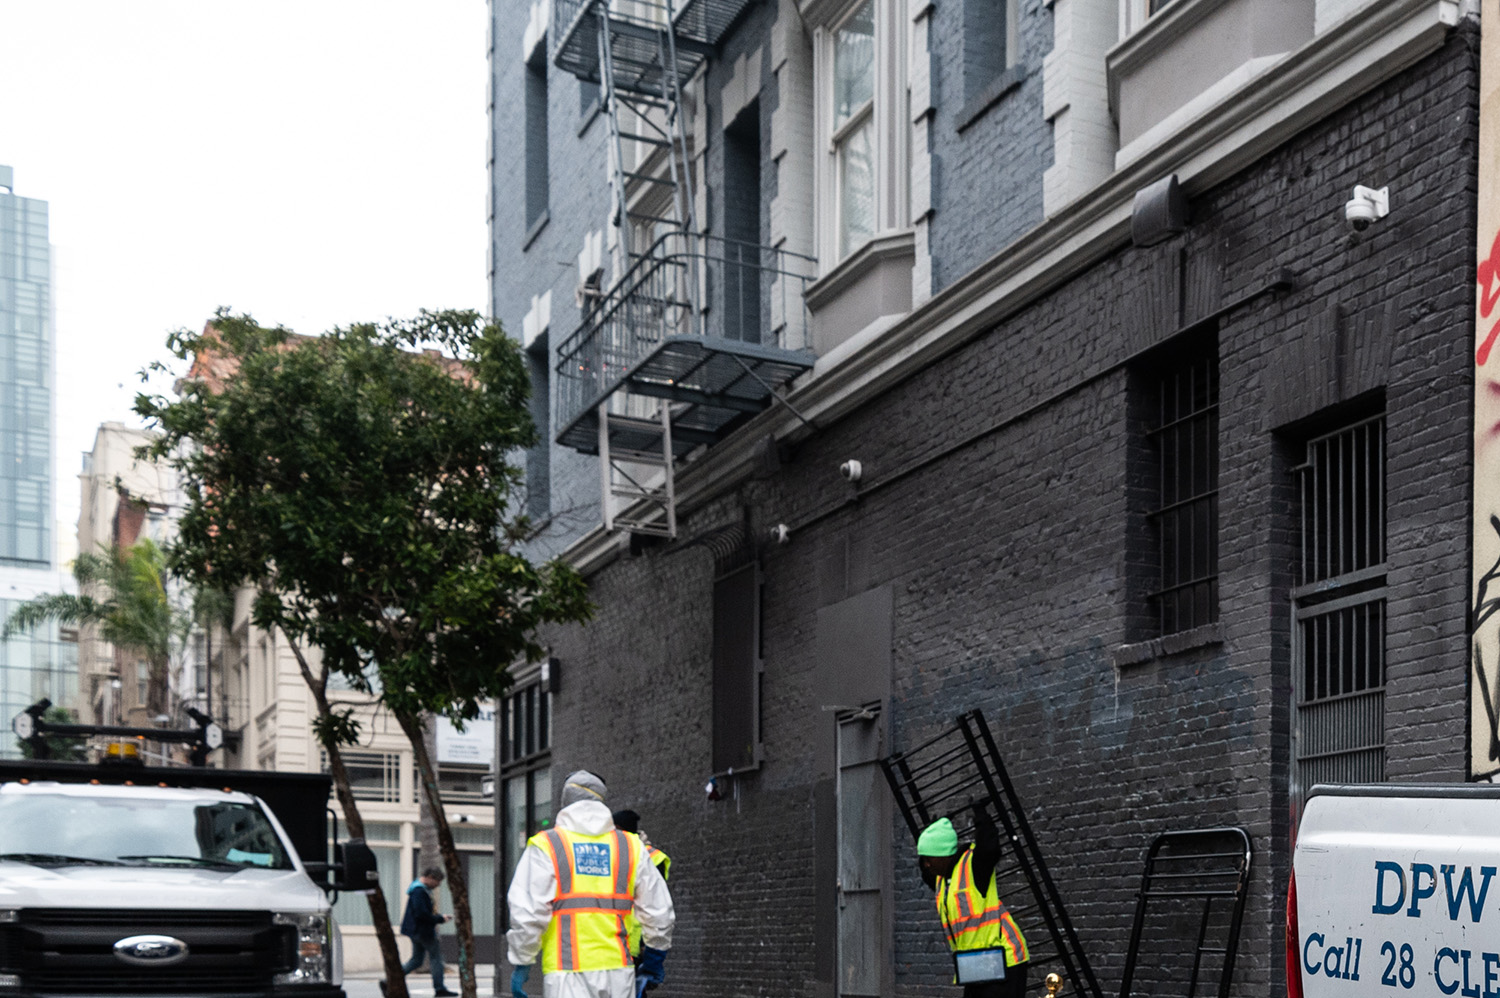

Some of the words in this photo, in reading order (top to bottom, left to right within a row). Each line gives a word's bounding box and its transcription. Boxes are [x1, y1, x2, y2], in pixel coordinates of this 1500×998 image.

[576, 858, 609, 867] PUBLIC
[577, 865, 609, 875] WORKS
[1372, 861, 1496, 922] DPW
[1303, 932, 1361, 981] Call
[1381, 941, 1415, 989] 28
